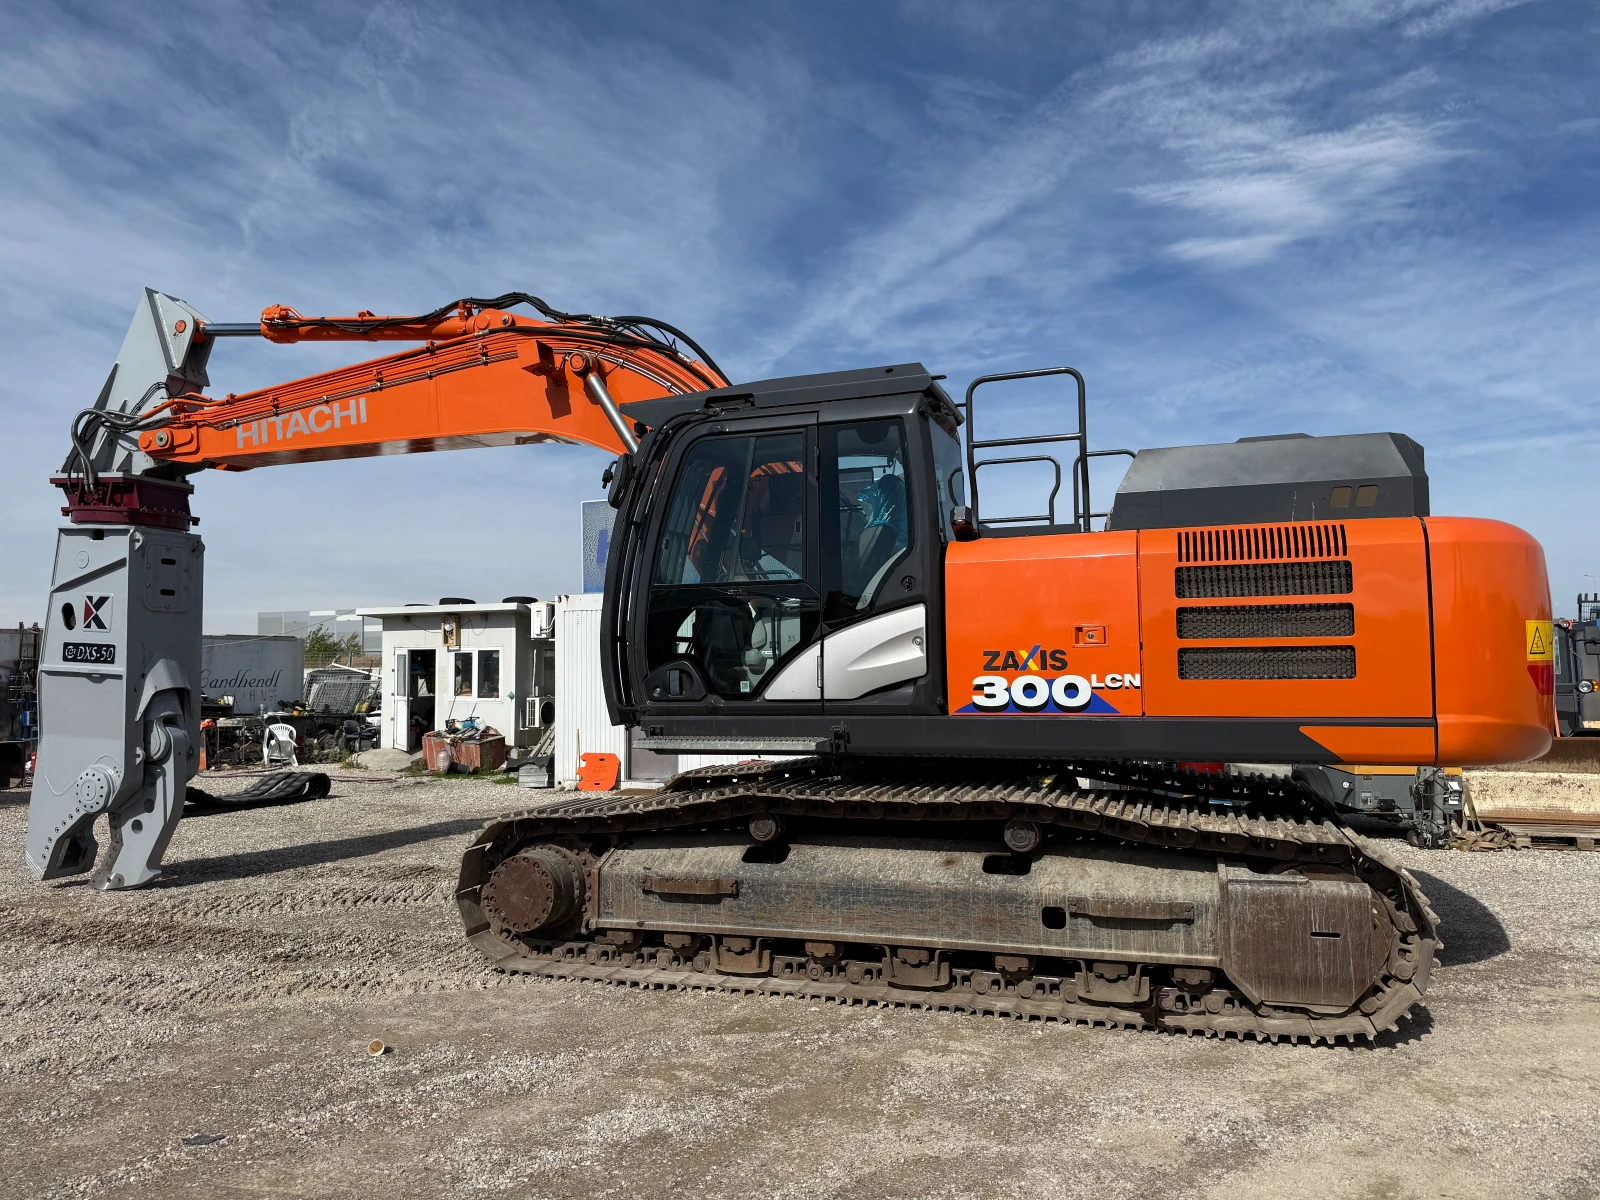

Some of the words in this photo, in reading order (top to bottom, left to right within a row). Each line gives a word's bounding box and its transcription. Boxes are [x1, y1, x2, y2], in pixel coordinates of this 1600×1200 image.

[236, 397, 368, 449] HITACHI
[77, 646, 114, 661] DXS-50
[983, 644, 1068, 671] ZAXIS
